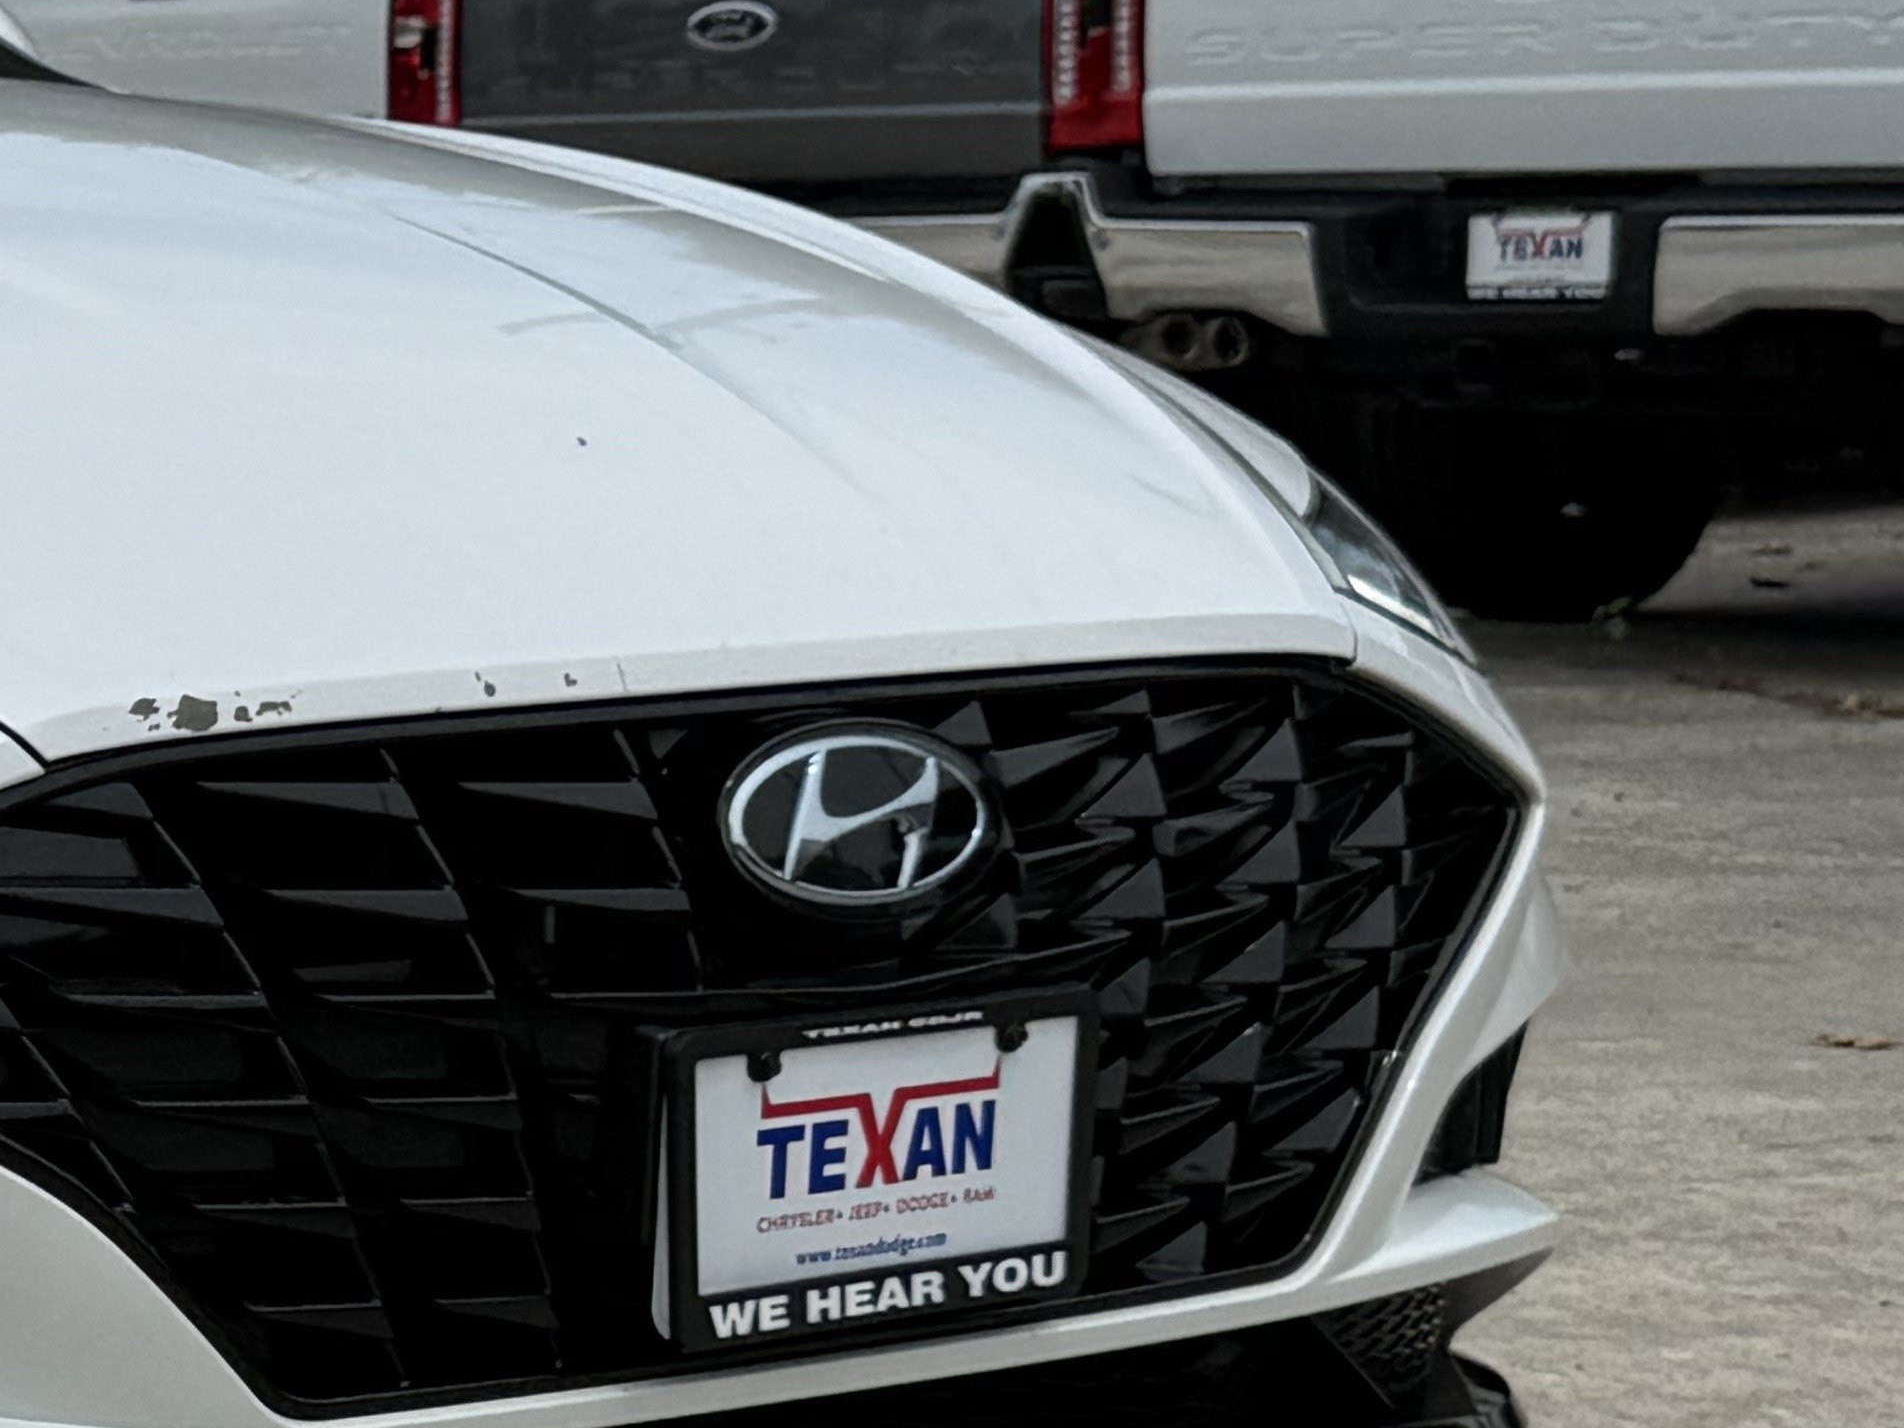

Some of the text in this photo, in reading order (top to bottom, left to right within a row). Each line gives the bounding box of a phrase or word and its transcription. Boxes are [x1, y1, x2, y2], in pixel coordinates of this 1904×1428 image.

[1182, 19, 1559, 65] SUPER
[757, 1088, 998, 1198] TEXAN
[709, 1250, 1067, 1339] WE HEAR YOU
